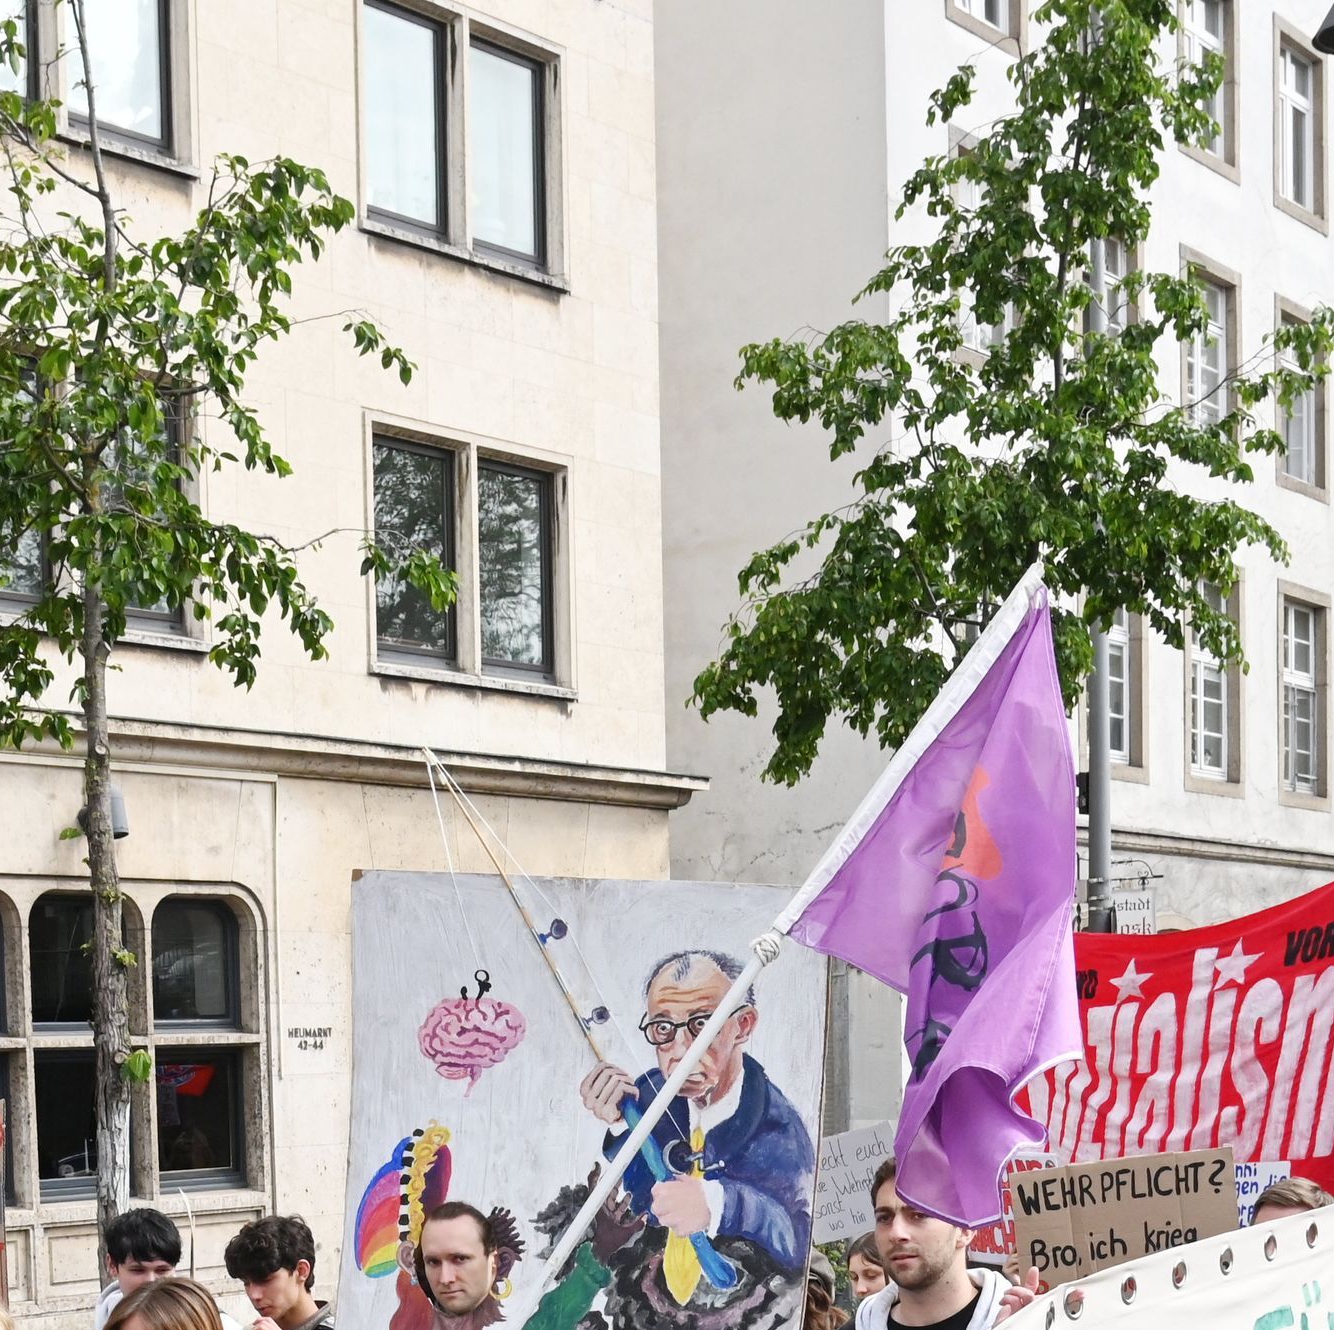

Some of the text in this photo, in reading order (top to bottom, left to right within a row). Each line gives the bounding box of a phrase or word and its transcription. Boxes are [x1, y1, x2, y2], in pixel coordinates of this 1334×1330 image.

[288, 1027, 332, 1038] HEUMARKT
[298, 1040, 324, 1050] 42-44
[856, 1131, 889, 1161] euch
[1018, 1159, 1226, 1217] WEHRPFLICHT?
[815, 1192, 847, 1219] sonst
[829, 1208, 866, 1231] wo hin
[1030, 1239, 1082, 1272] Bro,
[1089, 1228, 1127, 1261] ich
